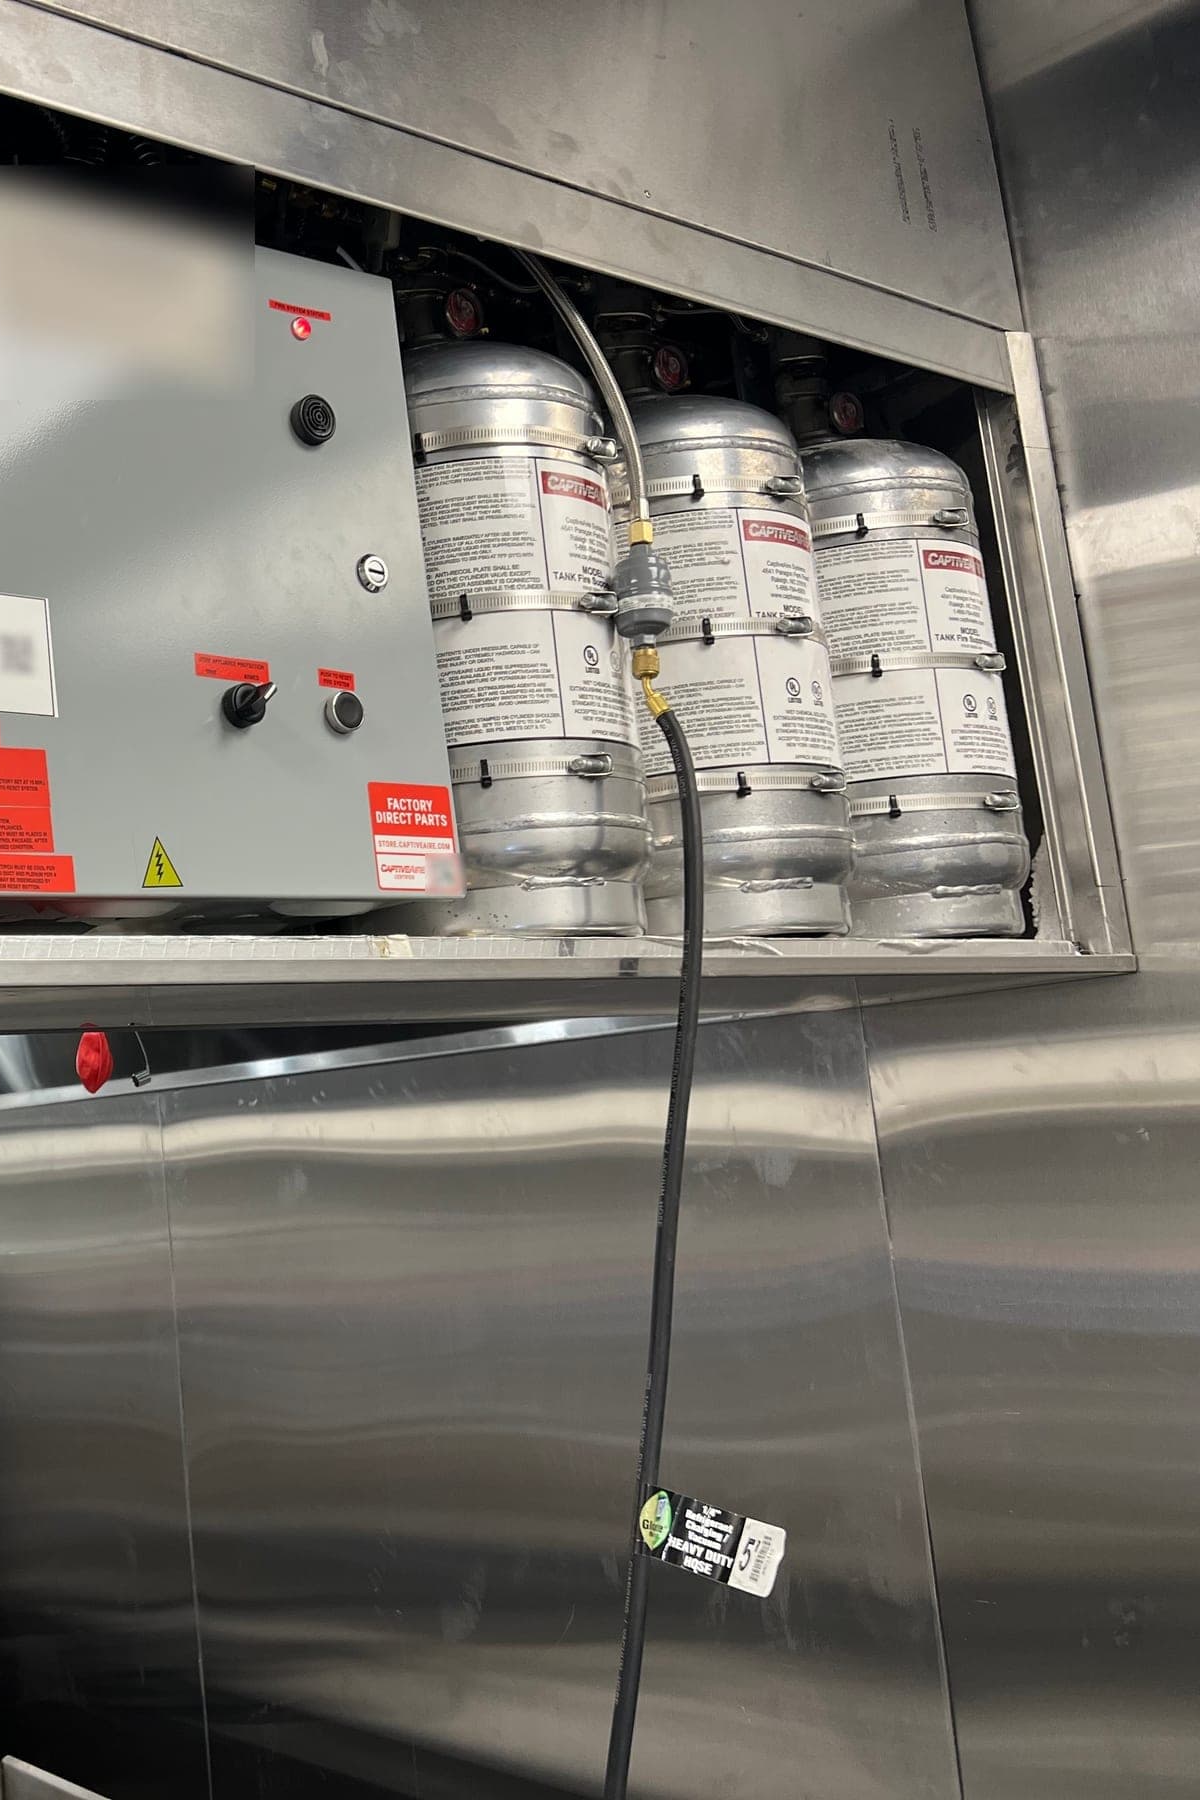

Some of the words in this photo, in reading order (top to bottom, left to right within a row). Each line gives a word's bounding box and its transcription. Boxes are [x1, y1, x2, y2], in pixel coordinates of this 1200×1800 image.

[553, 572, 576, 581] TANK
[387, 798, 433, 812] FACTORY
[376, 811, 413, 824] DIRECT
[414, 813, 447, 826] PARTS
[668, 1534, 706, 1558] HEAVY
[704, 1548, 734, 1568] DUTY
[683, 1555, 713, 1575] HOSE
